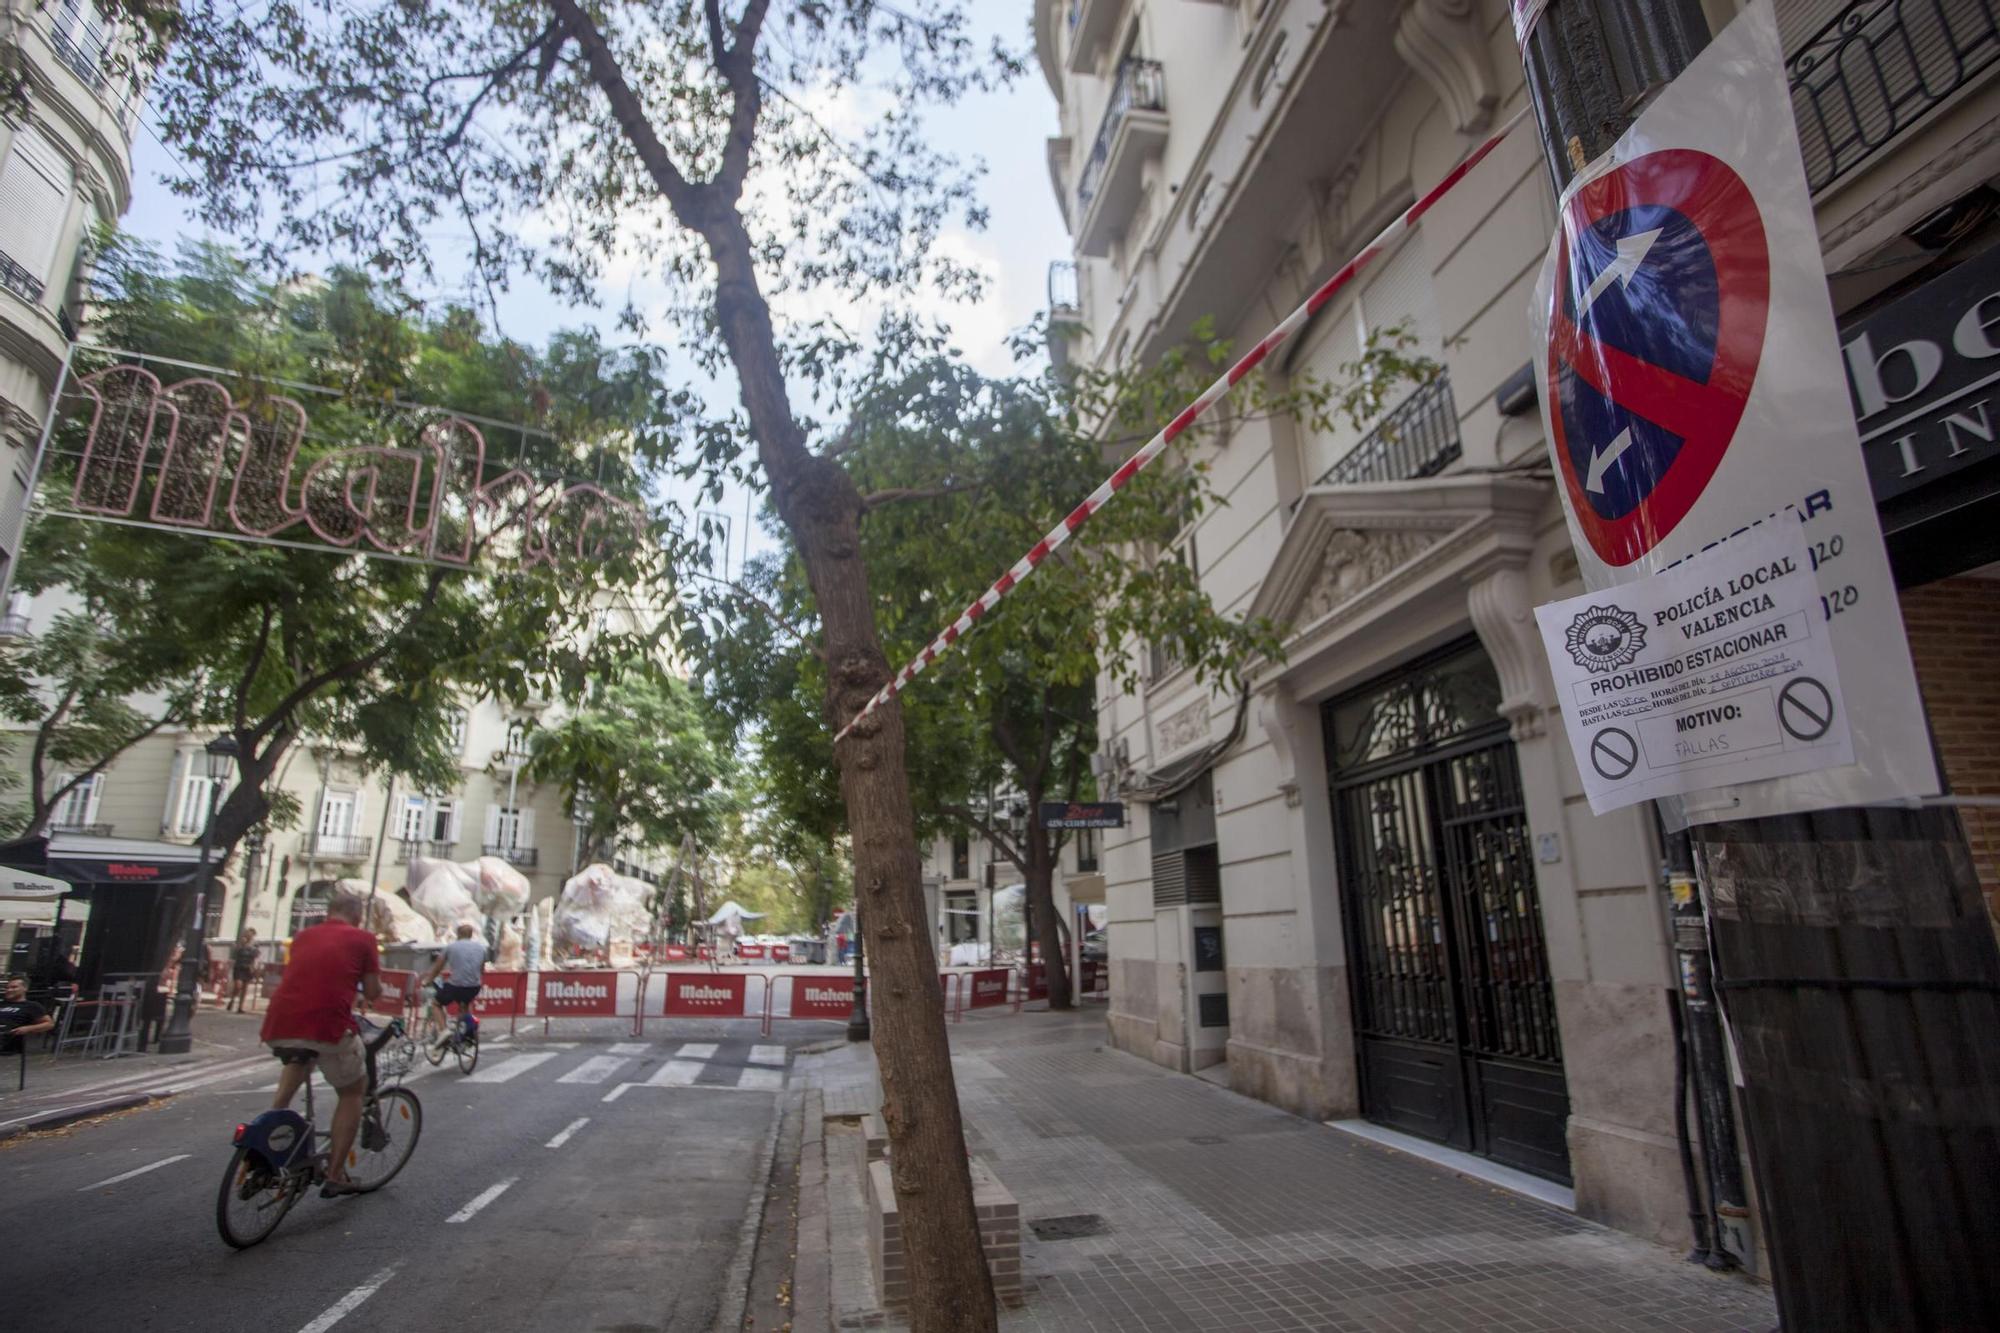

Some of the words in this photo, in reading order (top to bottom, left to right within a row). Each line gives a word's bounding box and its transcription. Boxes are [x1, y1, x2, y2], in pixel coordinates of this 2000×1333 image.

[1654, 586, 1724, 627] POLICÍA
[1728, 556, 1797, 597] LOCAL
[1681, 593, 1776, 640] VALENCIA
[1590, 659, 1684, 697] PROHIBIDO
[1686, 623, 1788, 671] ESTACIONAR
[1579, 702, 1603, 718] DESDE
[1603, 700, 1619, 711] LAS
[1581, 713, 1606, 728] HASTA
[1606, 709, 1622, 721] LAS
[1675, 704, 1742, 734] MOTIVO:
[1674, 734, 1731, 758] FALLAS
[545, 981, 608, 999] Mahou
[679, 985, 732, 1000] Mahou
